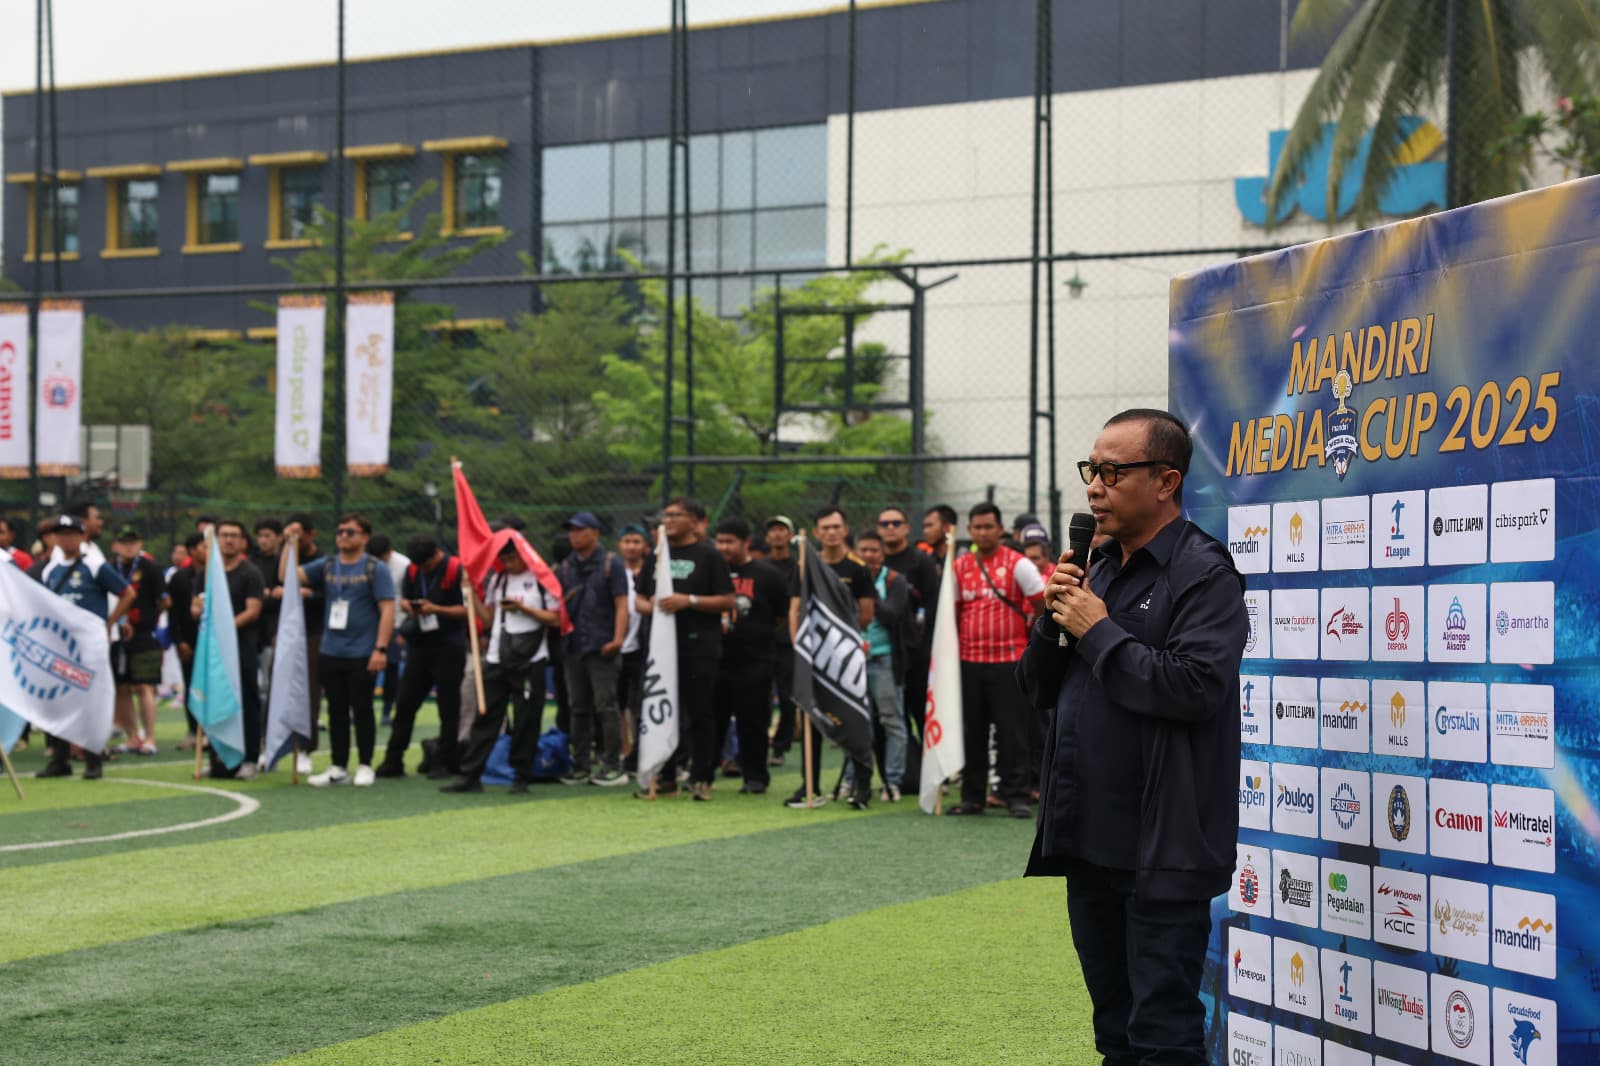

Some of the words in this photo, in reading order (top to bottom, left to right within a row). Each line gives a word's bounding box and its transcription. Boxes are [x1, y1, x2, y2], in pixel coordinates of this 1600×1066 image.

[1287, 314, 1435, 396] MANDIRI
[1225, 409, 1326, 478] MEDIA
[1360, 392, 1437, 462] CUP
[1438, 372, 1561, 453] 2025
[1444, 518, 1463, 533] LITTLE
[1464, 517, 1484, 532] JAPAN
[1495, 514, 1517, 528] cibis
[1517, 512, 1538, 530] park
[1229, 537, 1259, 554] mandiri
[1287, 552, 1305, 563] MILLS
[1511, 615, 1549, 630] amartha
[1442, 631, 1471, 643] Airlangga
[1387, 643, 1408, 651] DISPORA
[1446, 642, 1467, 651] Aksara
[1285, 705, 1301, 719] LITTLE
[1301, 706, 1315, 720] JAPAN
[1322, 711, 1358, 730] mandiri
[1496, 714, 1518, 727] MITRA
[1241, 721, 1259, 736] League
[1389, 735, 1409, 747] MILLS
[1239, 789, 1265, 809] aspen
[1284, 784, 1314, 814] bulog
[1435, 808, 1483, 833] Canon
[1509, 812, 1552, 834] Mitratel
[1393, 888, 1422, 902] Whoosh
[1327, 893, 1364, 914] Pegadaian
[1384, 917, 1415, 935] KCIC
[1495, 927, 1541, 952] mandiri
[1238, 968, 1266, 982] KEMENPORA
[1288, 991, 1307, 1006] MILLS
[1507, 1003, 1541, 1020] Garudafood
